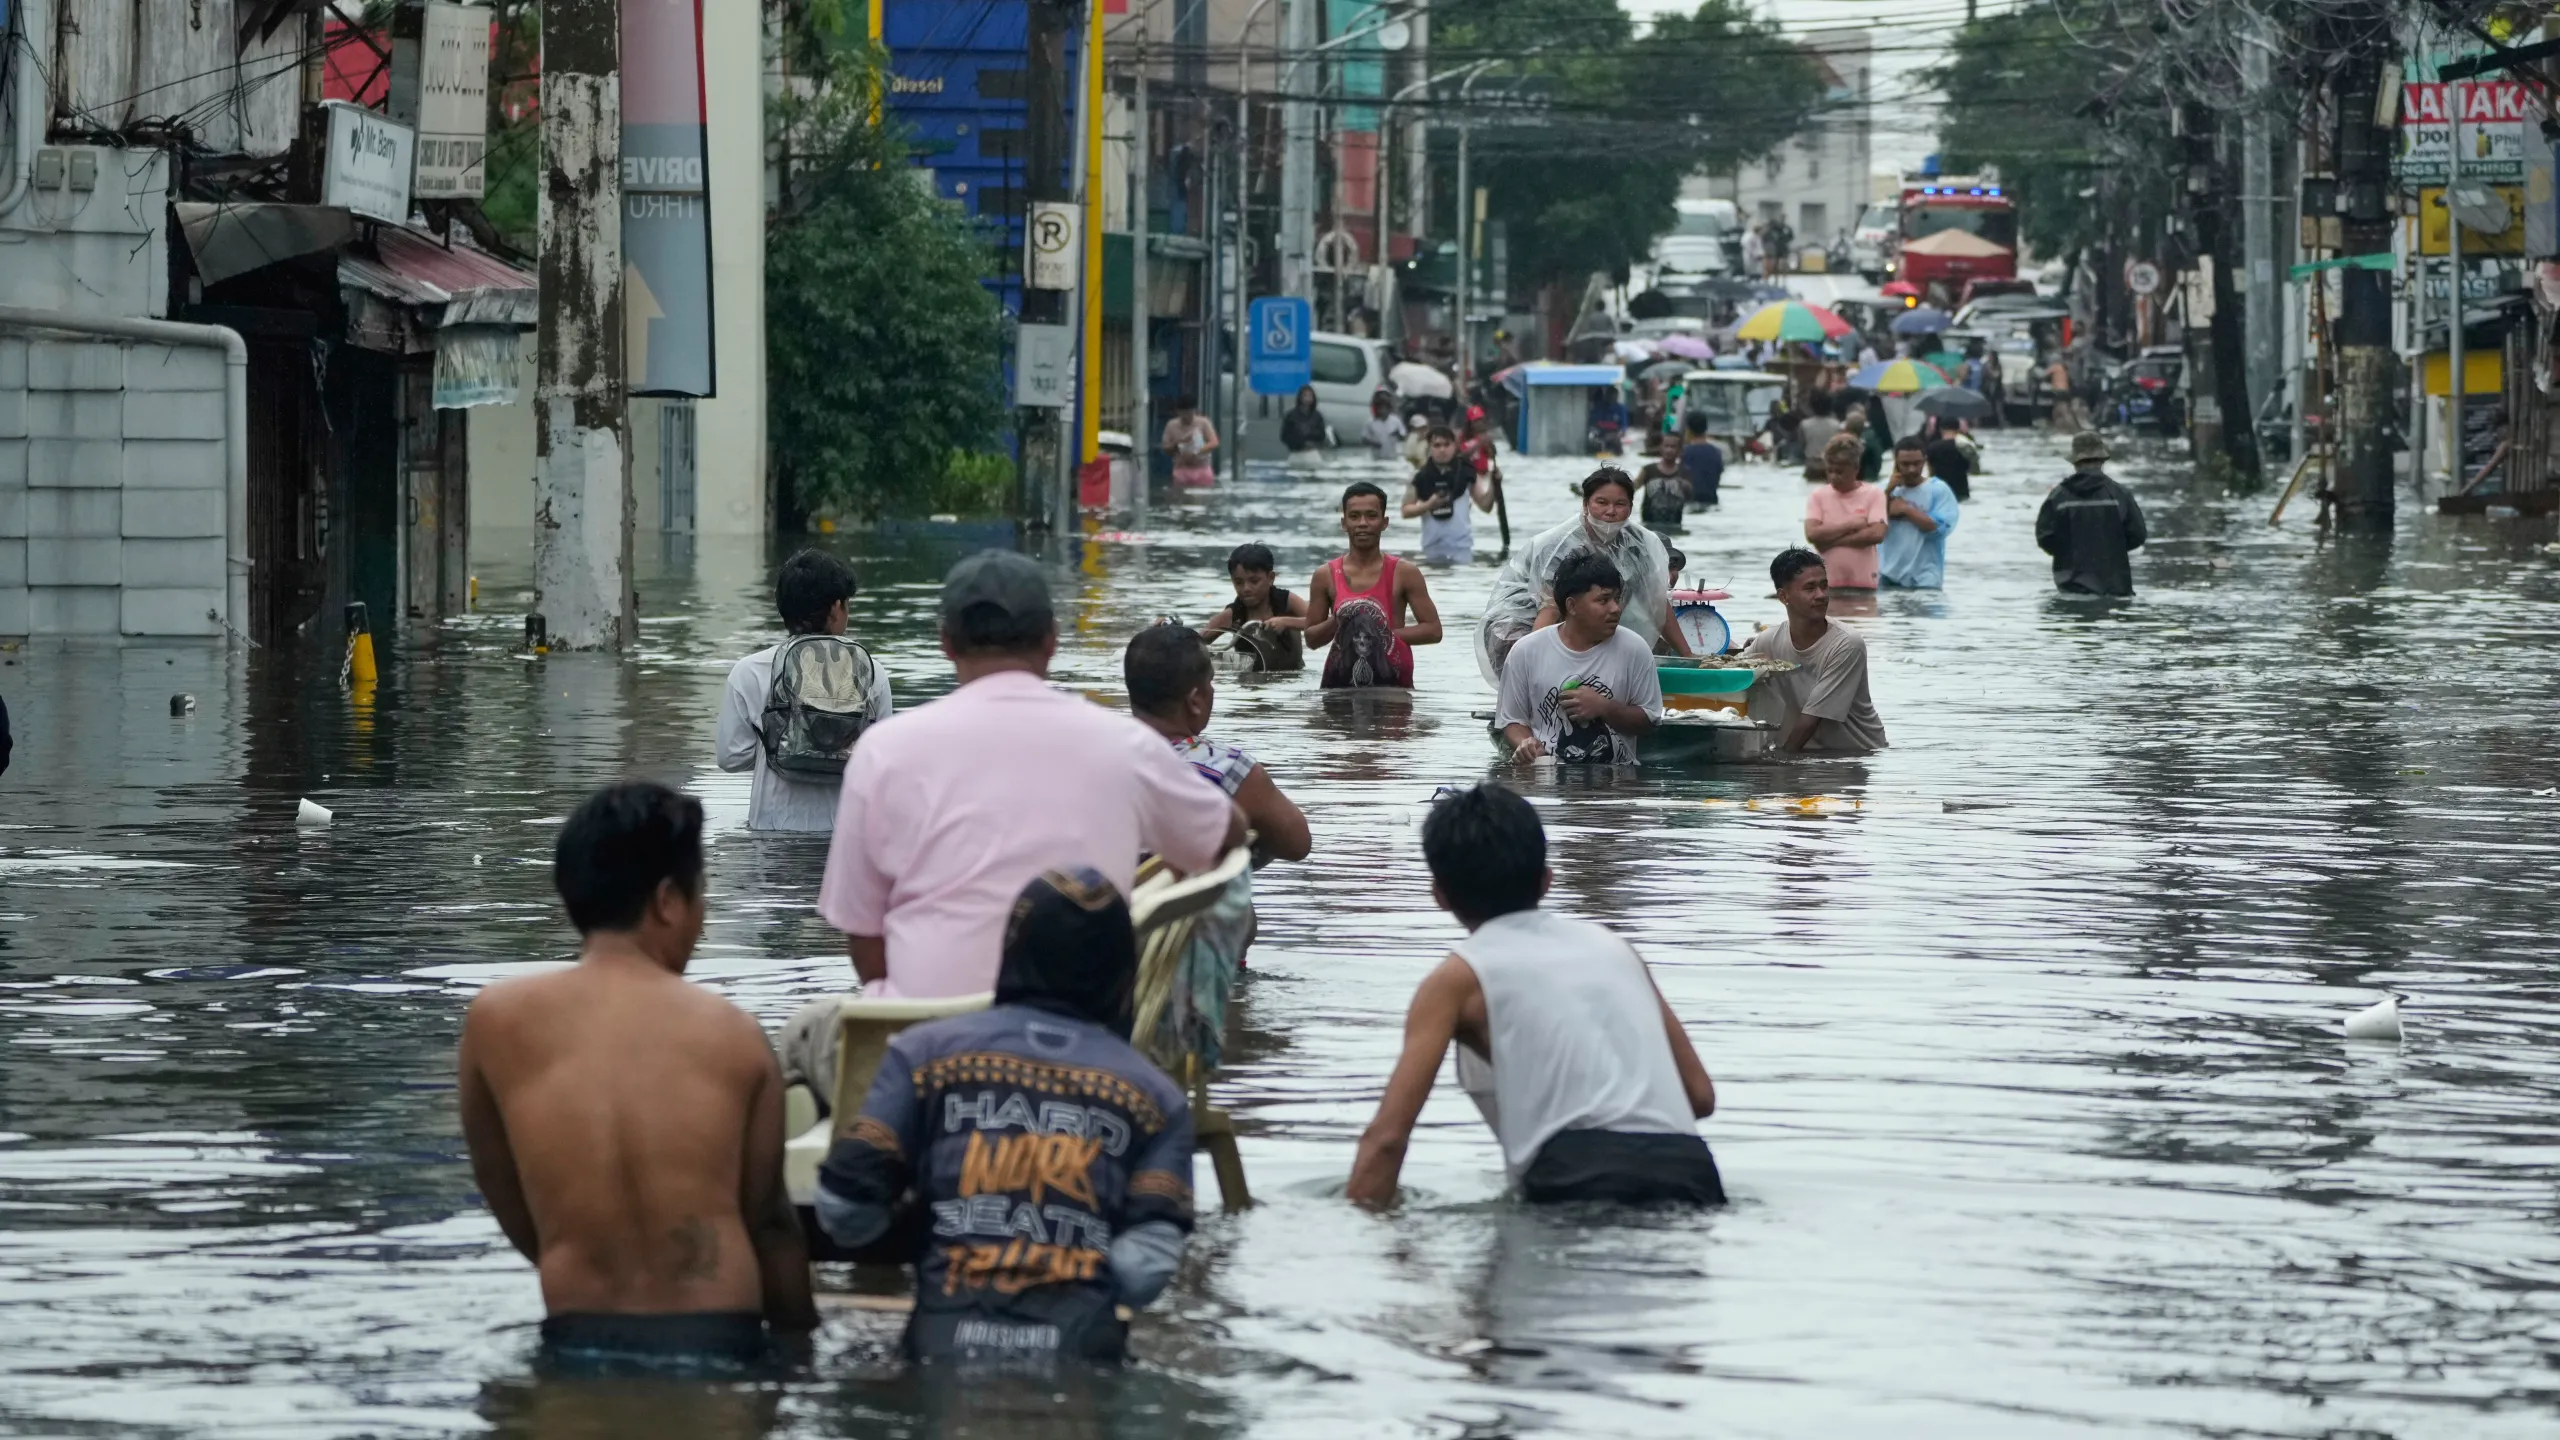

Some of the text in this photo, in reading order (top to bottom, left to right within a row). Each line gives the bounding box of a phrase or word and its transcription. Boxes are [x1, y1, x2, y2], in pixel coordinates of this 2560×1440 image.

[892, 77, 943, 93] Diesel
[378, 128, 397, 169] Barry
[944, 1090, 1131, 1158] HARD
[958, 1129, 1103, 1214] WORK
